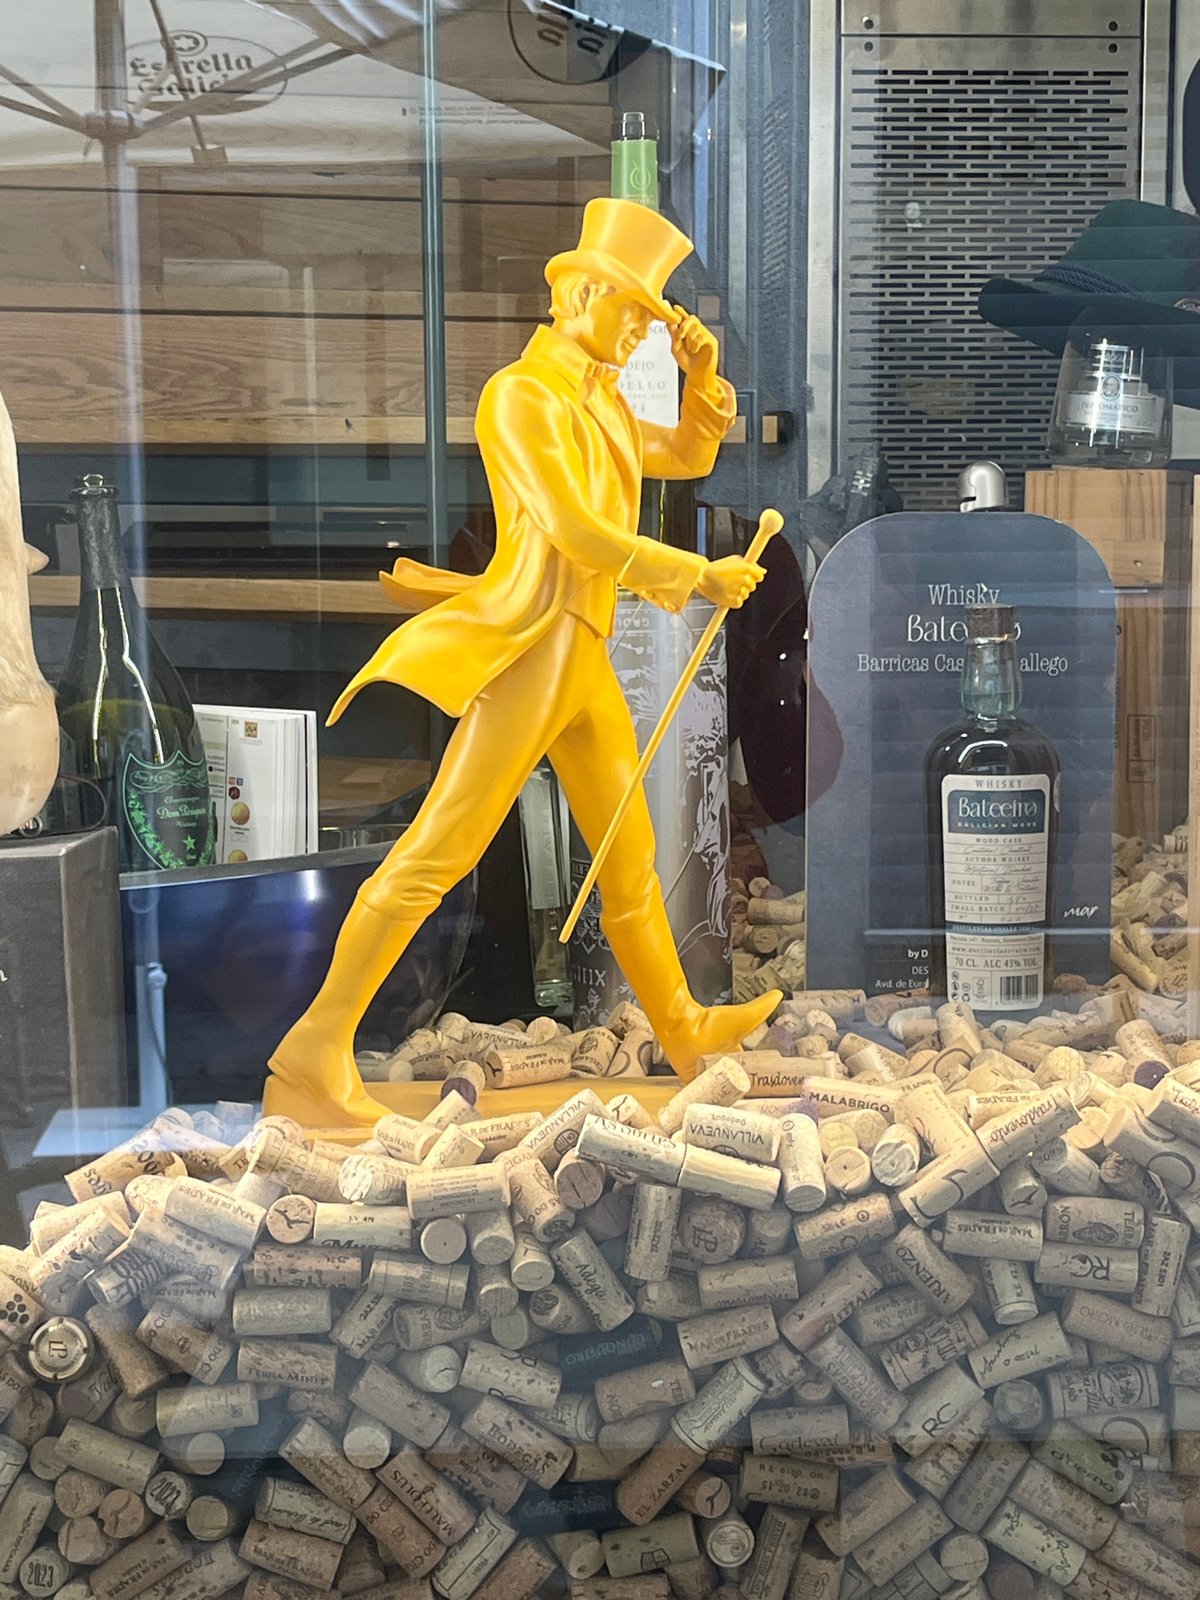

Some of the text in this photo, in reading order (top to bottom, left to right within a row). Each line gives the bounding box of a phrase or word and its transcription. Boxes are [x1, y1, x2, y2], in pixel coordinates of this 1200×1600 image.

[130, 52, 253, 77] Esrella
[928, 582, 1001, 606] Whisky
[857, 653, 929, 673] Barricas
[1019, 652, 1069, 677] allego
[975, 779, 1023, 789] WHISKY
[1063, 905, 1099, 919] mar
[907, 948, 920, 960] by
[954, 957, 964, 967] 70
[983, 958, 1001, 969] ALC
[1004, 958, 1021, 968] 43%
[750, 1070, 804, 1088] Trasdoven
[808, 1090, 891, 1114] MALABRIGO
[526, 1098, 588, 1151] VILLANUEVA
[989, 1095, 1060, 1144] Trasdovento
[688, 1122, 765, 1146] VILLANUEVA
[177, 1183, 222, 1209] FRADES
[956, 1222, 1000, 1234] FRADES
[1014, 1225, 1034, 1239] MAR
[574, 1256, 608, 1300] Adega
[921, 1401, 960, 1439] RC
[486, 1421, 552, 1477] BODEGAS
[649, 1461, 691, 1504] ZARZAL
[389, 1467, 457, 1538] MALLEOLUS
[26, 1562, 55, 1588] 2023
